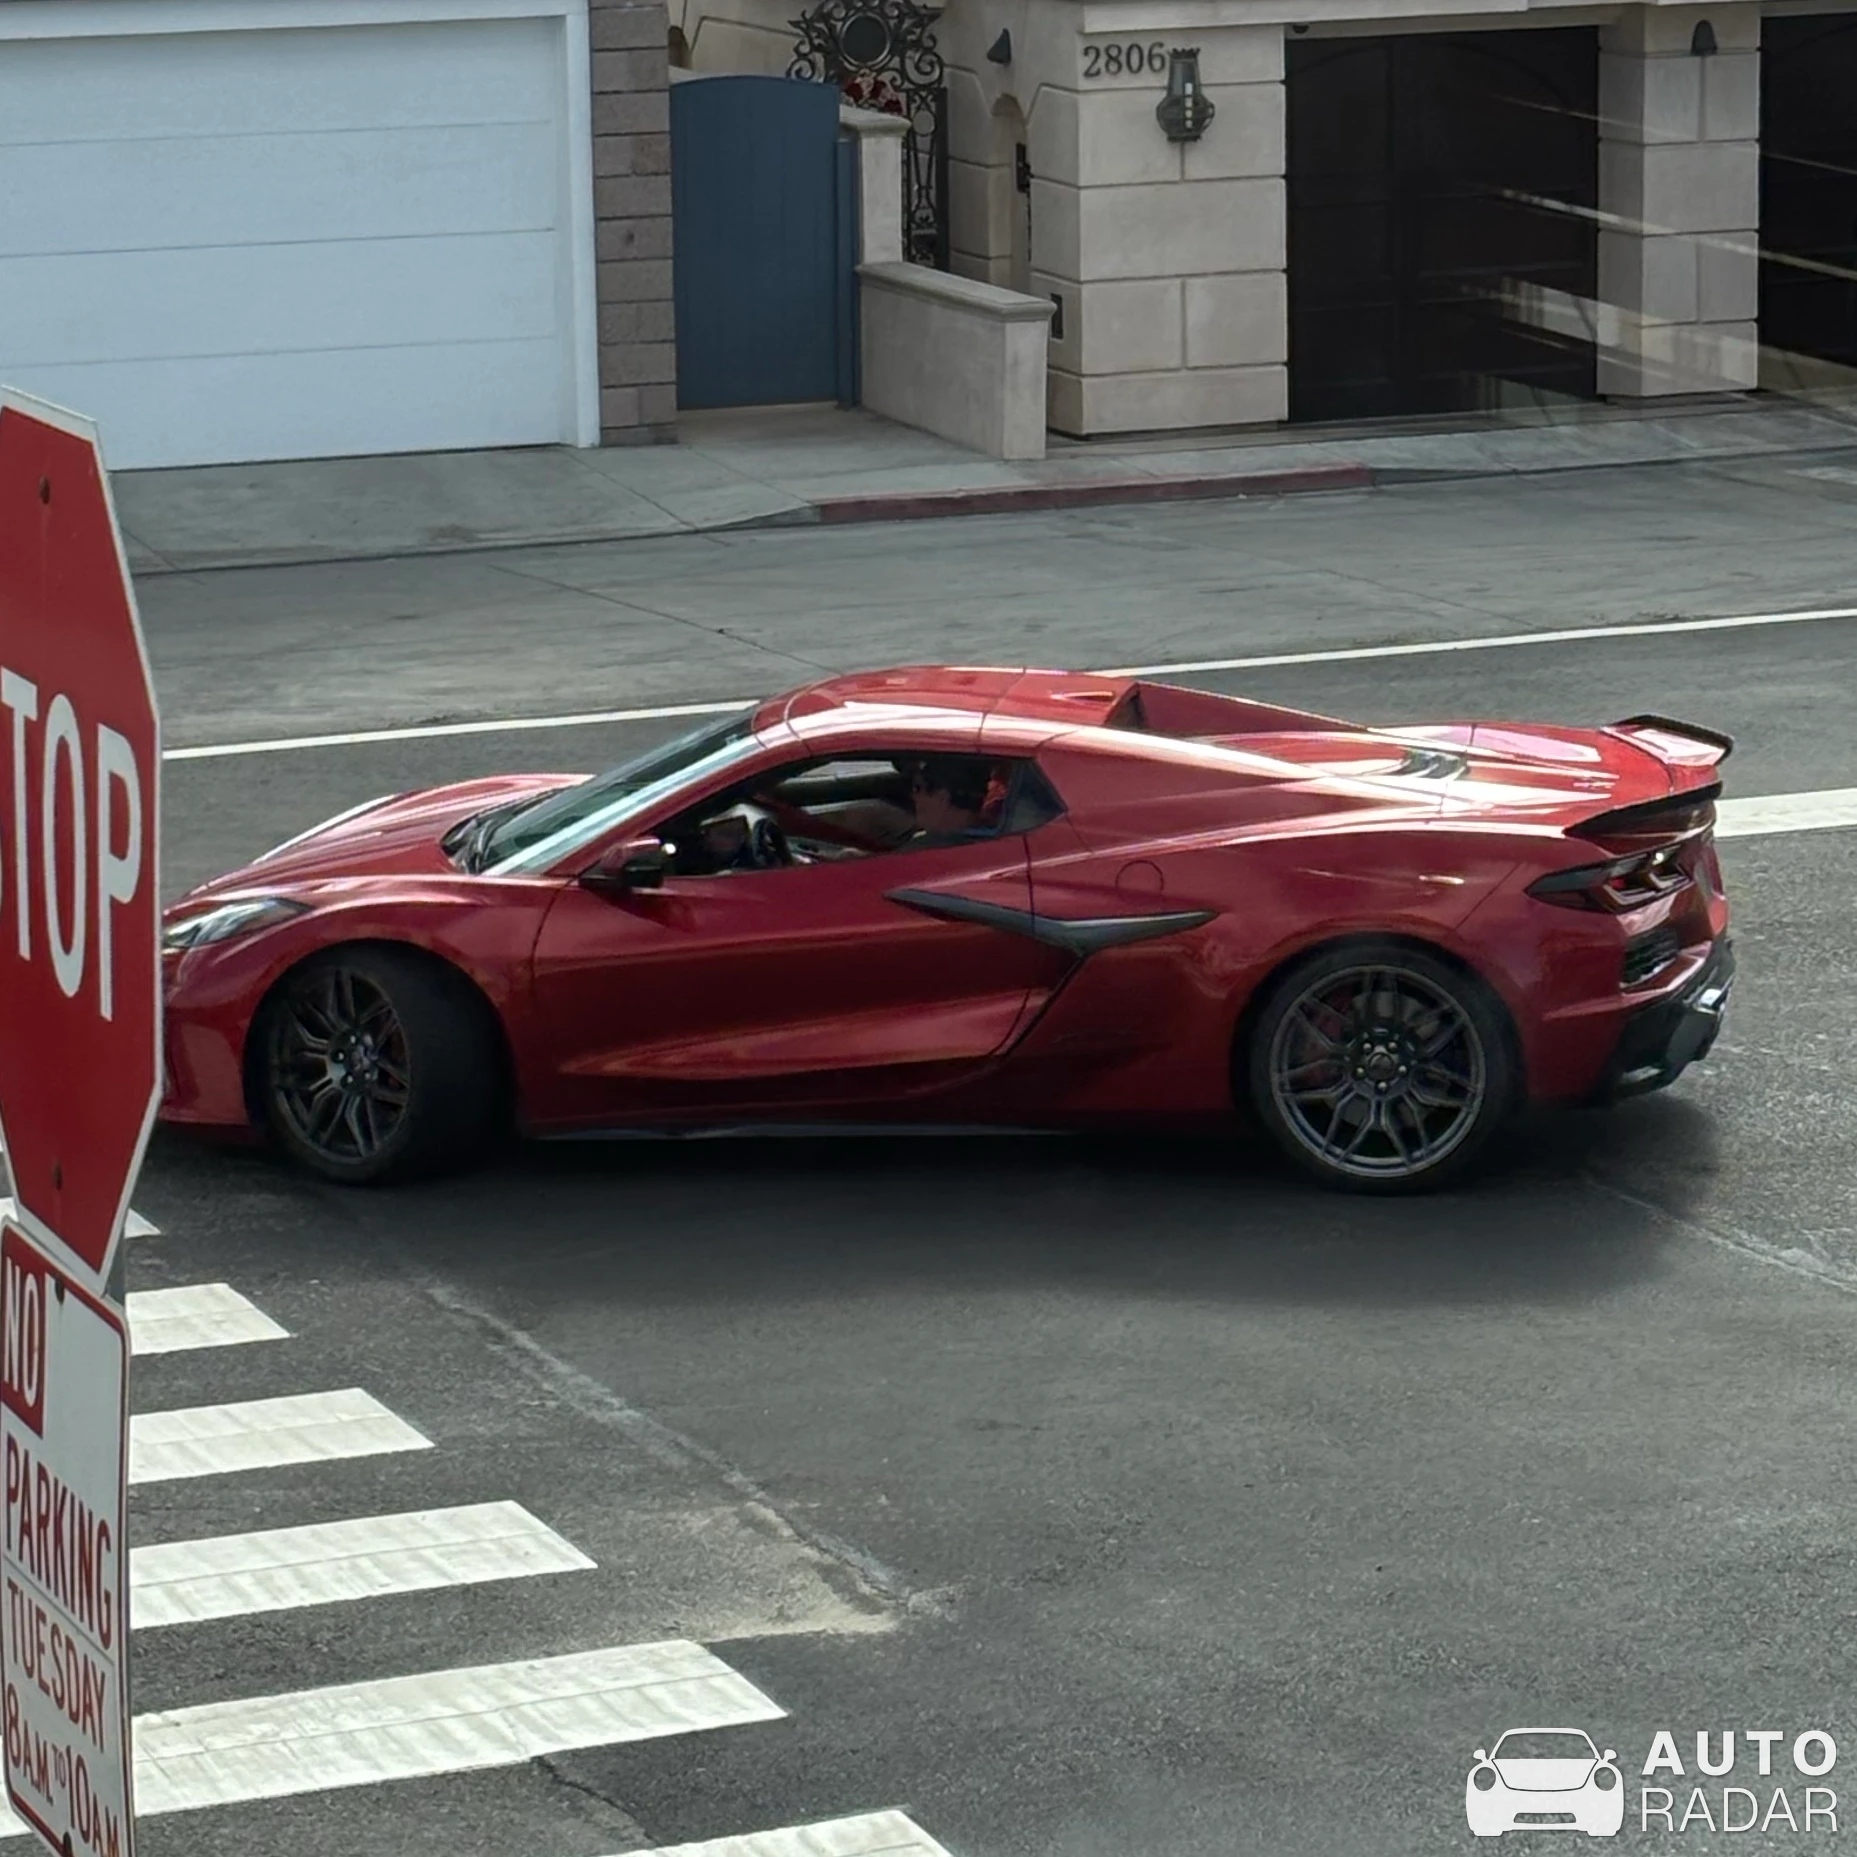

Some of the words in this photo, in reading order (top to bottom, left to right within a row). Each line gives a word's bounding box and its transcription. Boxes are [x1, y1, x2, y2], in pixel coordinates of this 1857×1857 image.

[1083, 41, 1166, 78] 2806
[0, 666, 141, 1022] TOP
[4, 1256, 39, 1408] NO
[7, 1431, 111, 1651] PARKING
[7, 1576, 106, 1754] TUESDAY
[52, 1743, 67, 1789] TO
